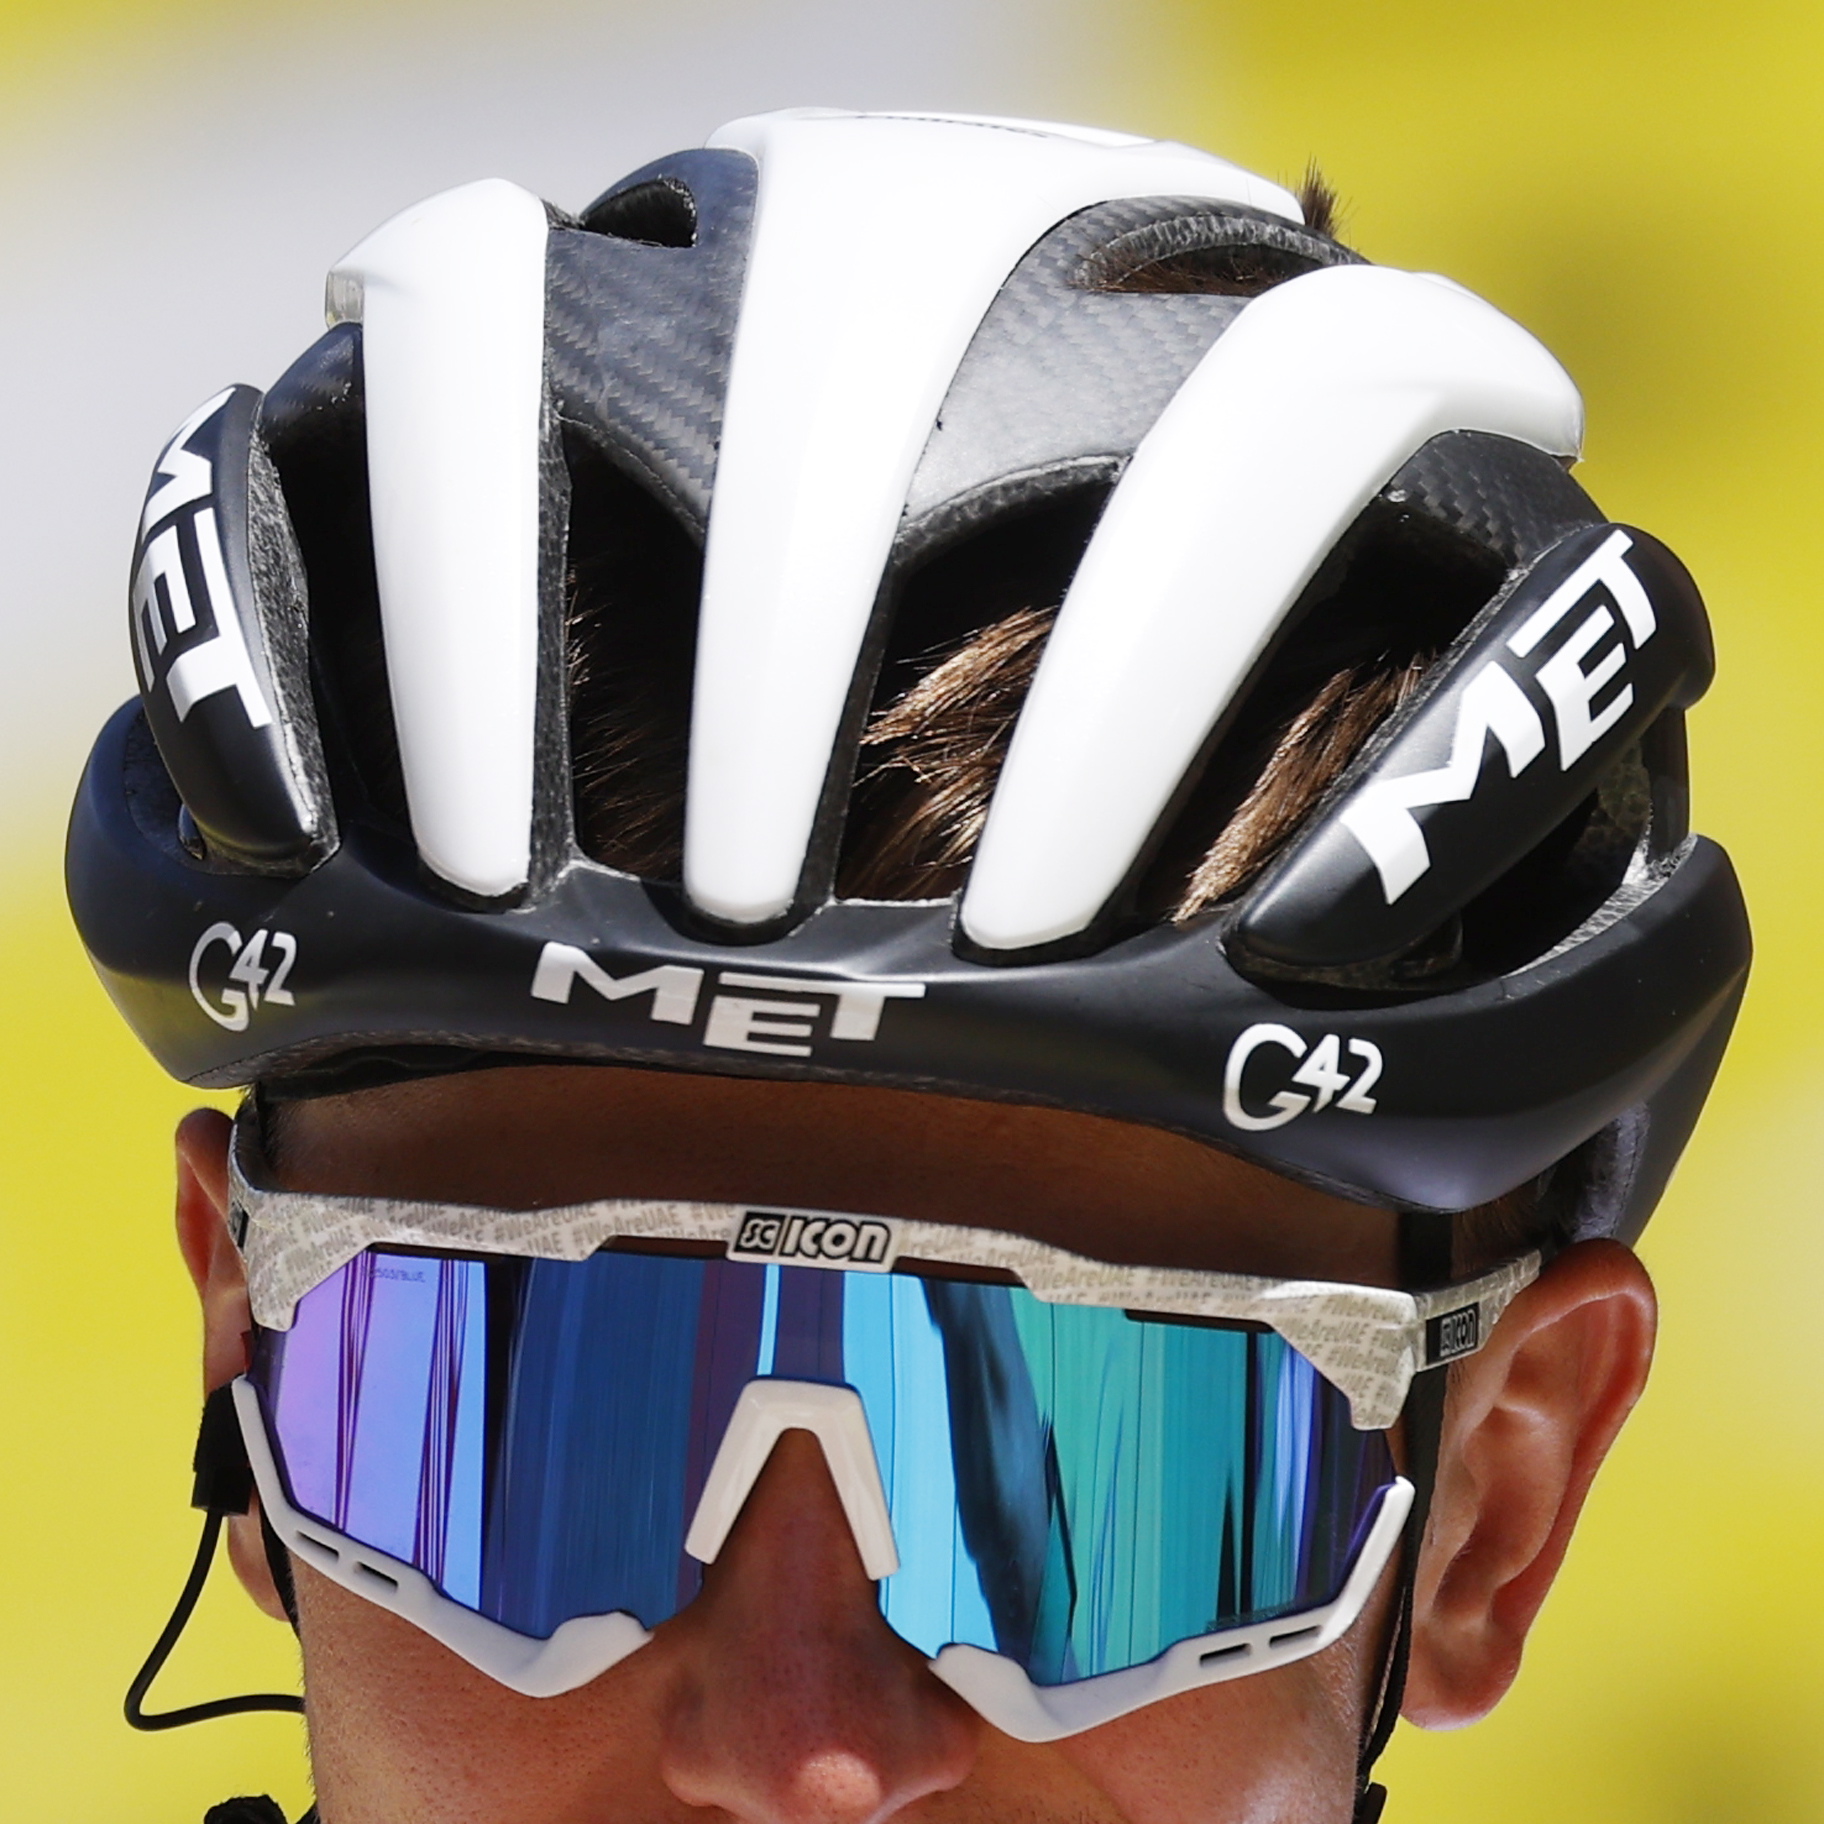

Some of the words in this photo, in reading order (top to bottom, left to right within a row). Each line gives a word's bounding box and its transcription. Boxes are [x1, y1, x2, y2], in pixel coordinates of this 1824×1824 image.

[133, 387, 273, 730] MET
[1340, 528, 1657, 906] MET
[188, 921, 297, 1033] G42
[531, 941, 926, 1058] MET
[1222, 1022, 1384, 1132] G42
